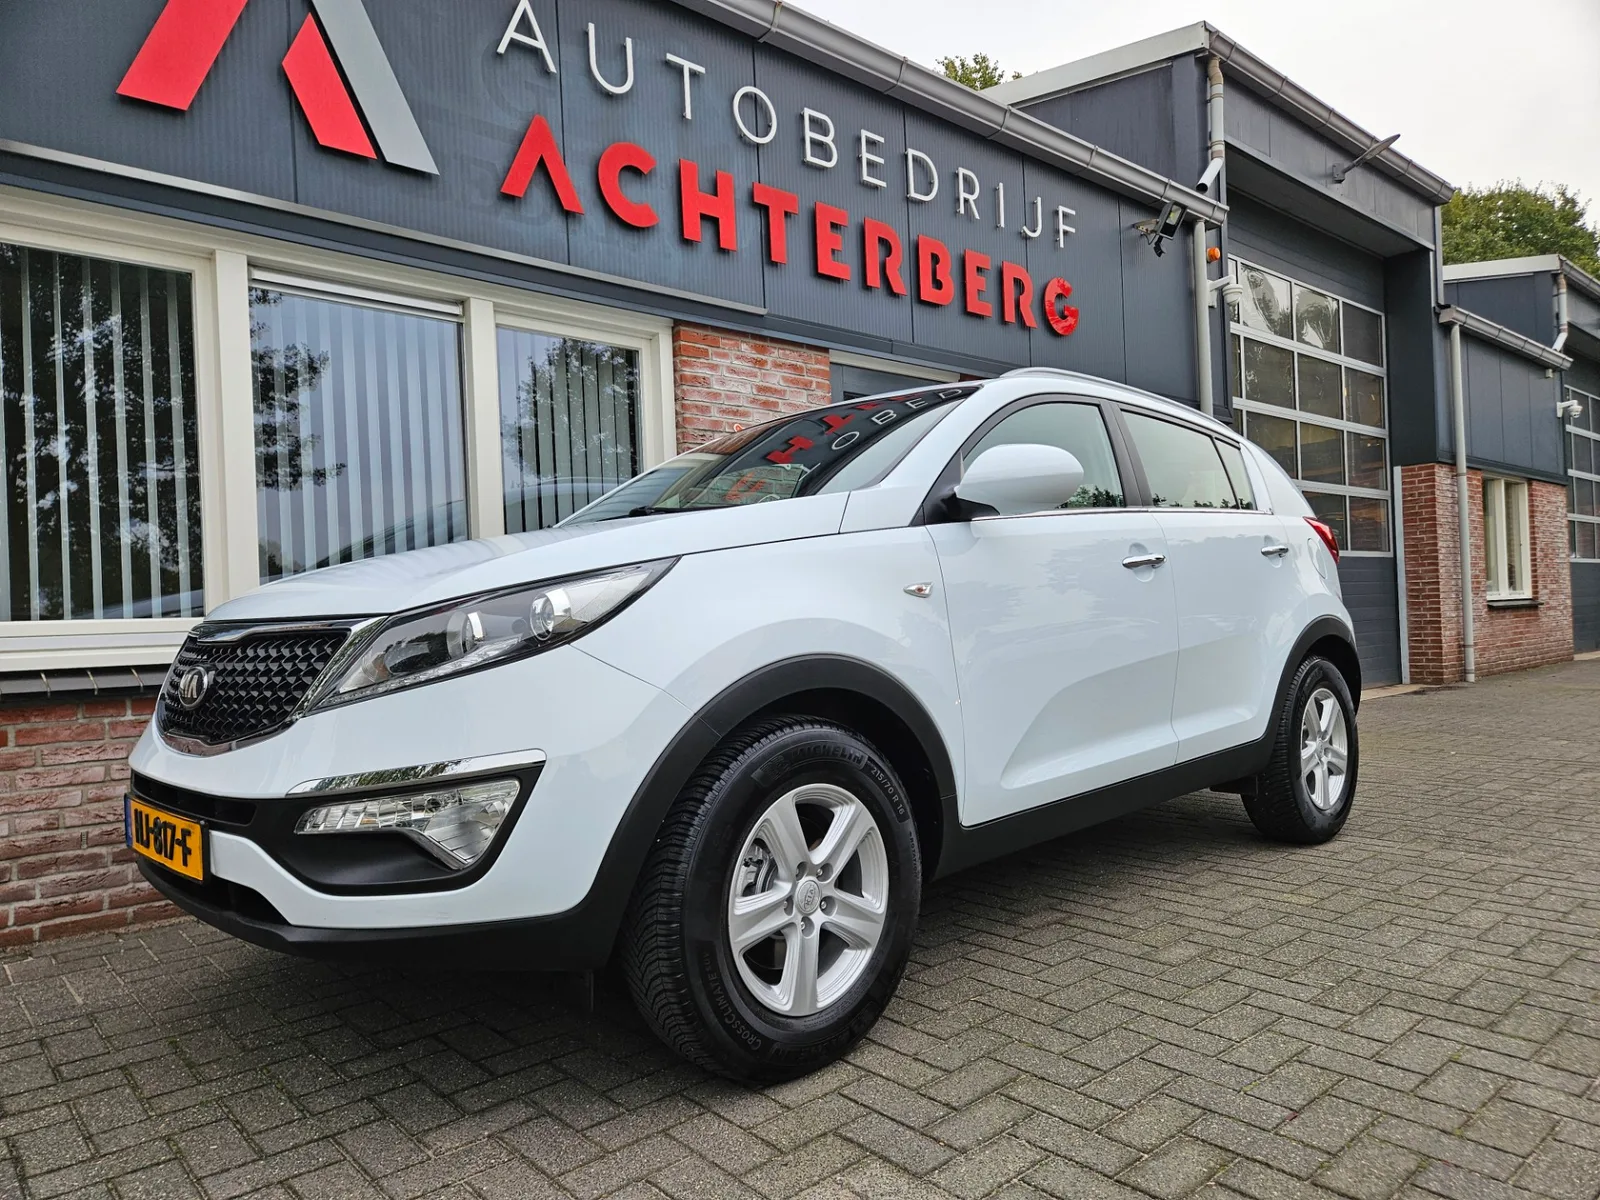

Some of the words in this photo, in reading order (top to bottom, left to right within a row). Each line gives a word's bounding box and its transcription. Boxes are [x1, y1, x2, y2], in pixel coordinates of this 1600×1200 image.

[496, 0, 1076, 249] AUTOBEDRIJF
[500, 114, 1079, 336] ACHTERBERG
[791, 744, 864, 765] MICHELIN
[870, 767, 894, 794] 215/70
[892, 794, 899, 803] R
[897, 803, 905, 815] 16
[707, 972, 762, 1051] CROSSCLIMATE
